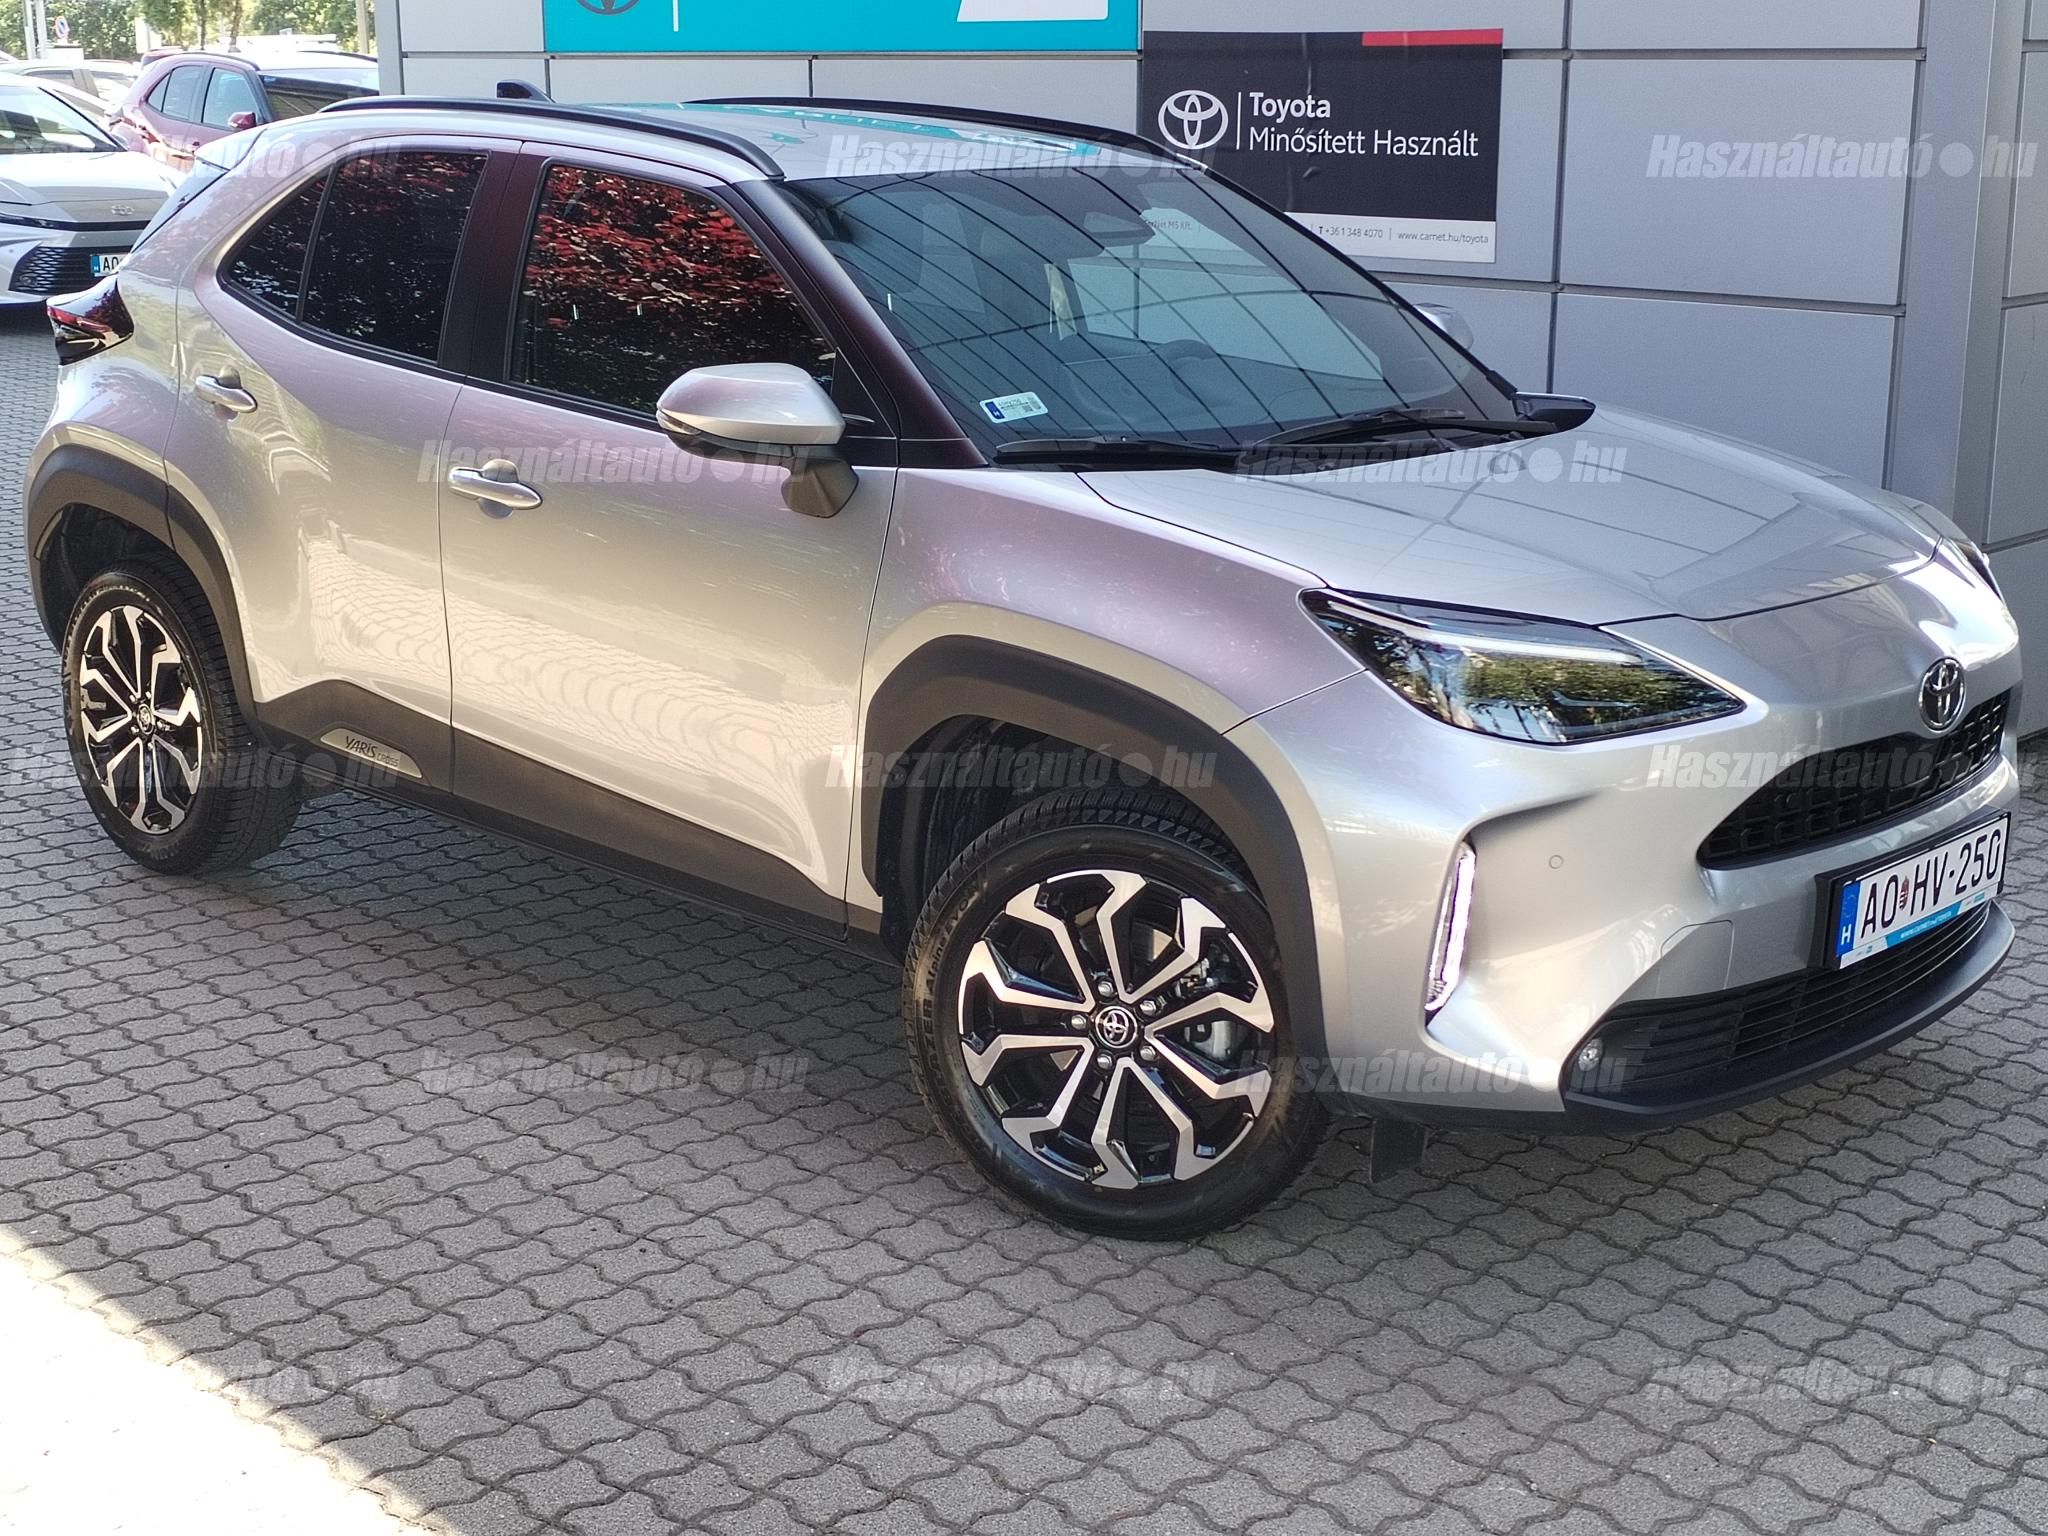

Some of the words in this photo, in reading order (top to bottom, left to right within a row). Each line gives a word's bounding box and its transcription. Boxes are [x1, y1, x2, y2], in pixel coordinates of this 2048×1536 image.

[1250, 92, 1331, 123] Toyota
[1250, 125, 1365, 153] Minősített
[1374, 129, 1479, 157] Használt
[345, 735, 378, 758] YARIS
